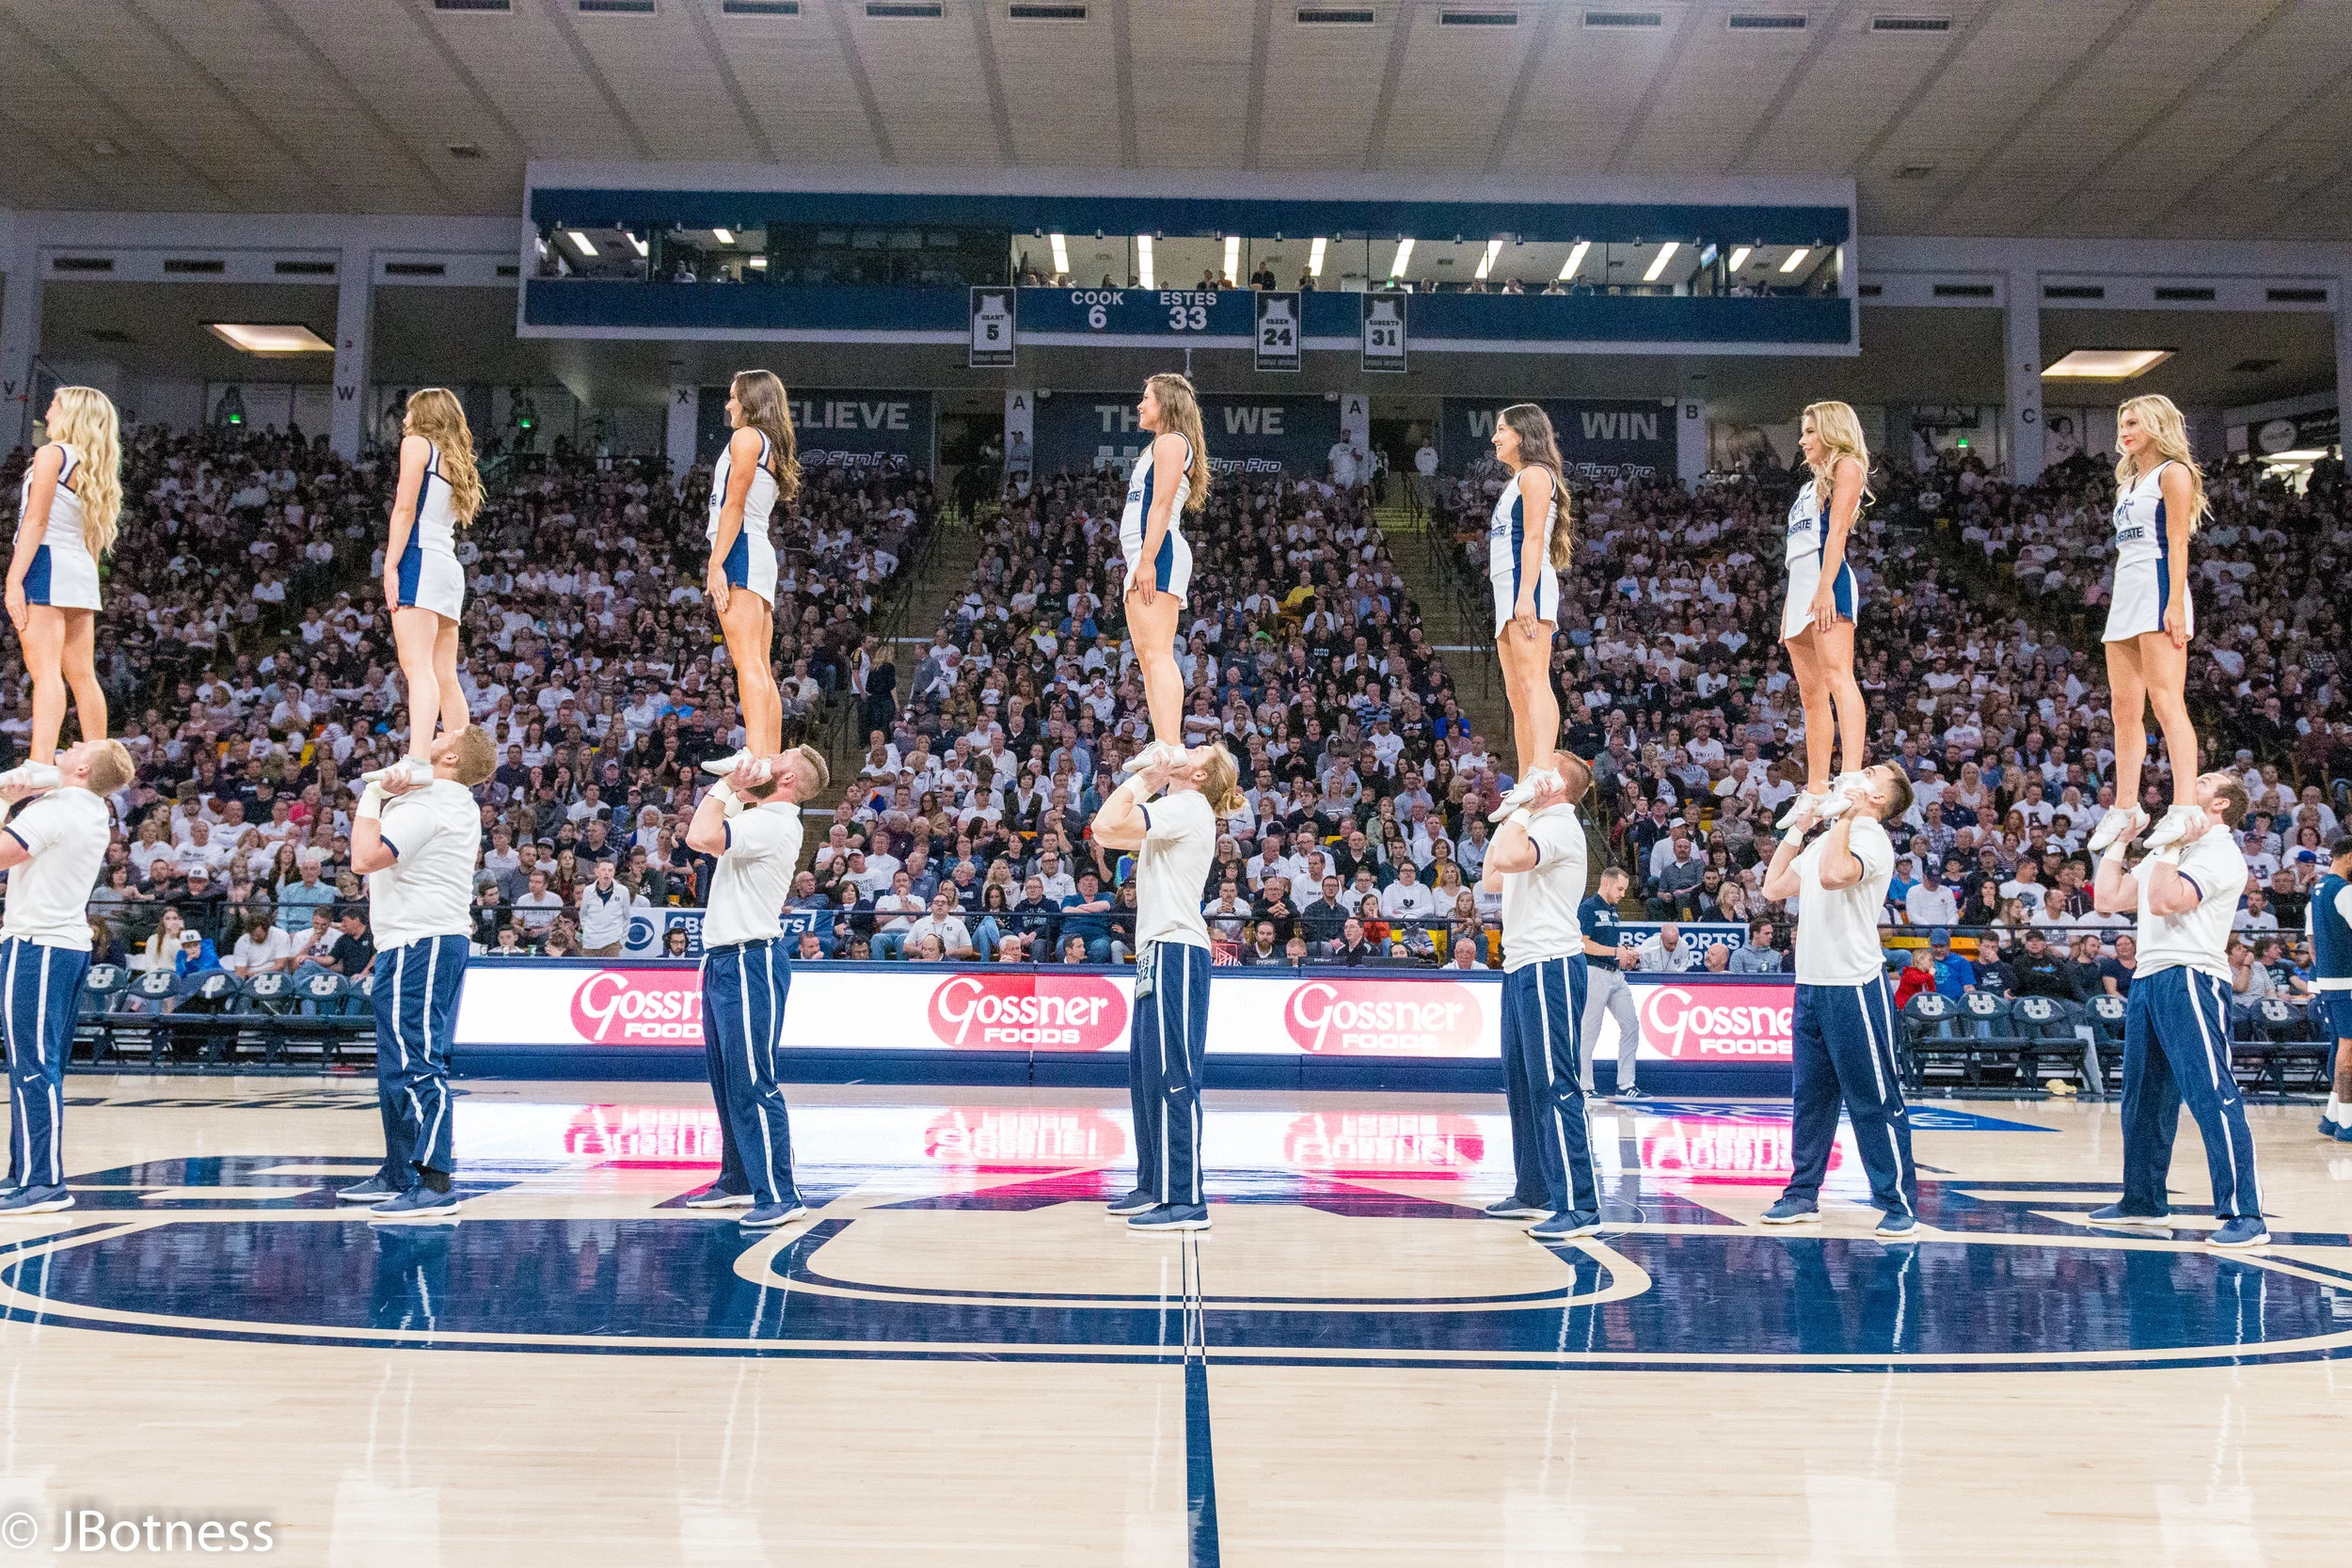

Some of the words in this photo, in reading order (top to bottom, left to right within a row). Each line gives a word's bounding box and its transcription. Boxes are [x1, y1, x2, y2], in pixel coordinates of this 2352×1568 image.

[1071, 291, 1124, 306] COOK
[1159, 291, 1217, 306] ESTES
[1088, 305, 1107, 329] 6
[1168, 306, 1208, 330] 33
[986, 324, 999, 341] 5
[1263, 328, 1293, 346] 24
[1372, 329, 1397, 346] 31
[3, 381, 15, 395] V
[337, 386, 356, 400] W
[676, 389, 689, 404] X
[1012, 395, 1026, 410] A
[1348, 400, 1362, 415] A
[787, 402, 910, 430] ELIEVE
[1224, 406, 1285, 435] WE
[1685, 404, 1699, 420] B
[2022, 408, 2036, 424] C
[1581, 412, 1658, 440] WIN
[1246, 457, 1282, 473] Pro
[669, 916, 706, 934] CB
[1619, 931, 1647, 948] BS
[1678, 932, 1740, 950] ORTS
[580, 973, 704, 1040] Gossn
[938, 977, 1109, 1045] Gossner
[1294, 982, 1464, 1051] Gossner
[1648, 988, 1792, 1056] Gossne
[625, 1022, 704, 1038] FOOD
[984, 1027, 1080, 1044] FOODS
[1342, 1034, 1438, 1050] FOODS
[1699, 1038, 1792, 1054] FOODS
